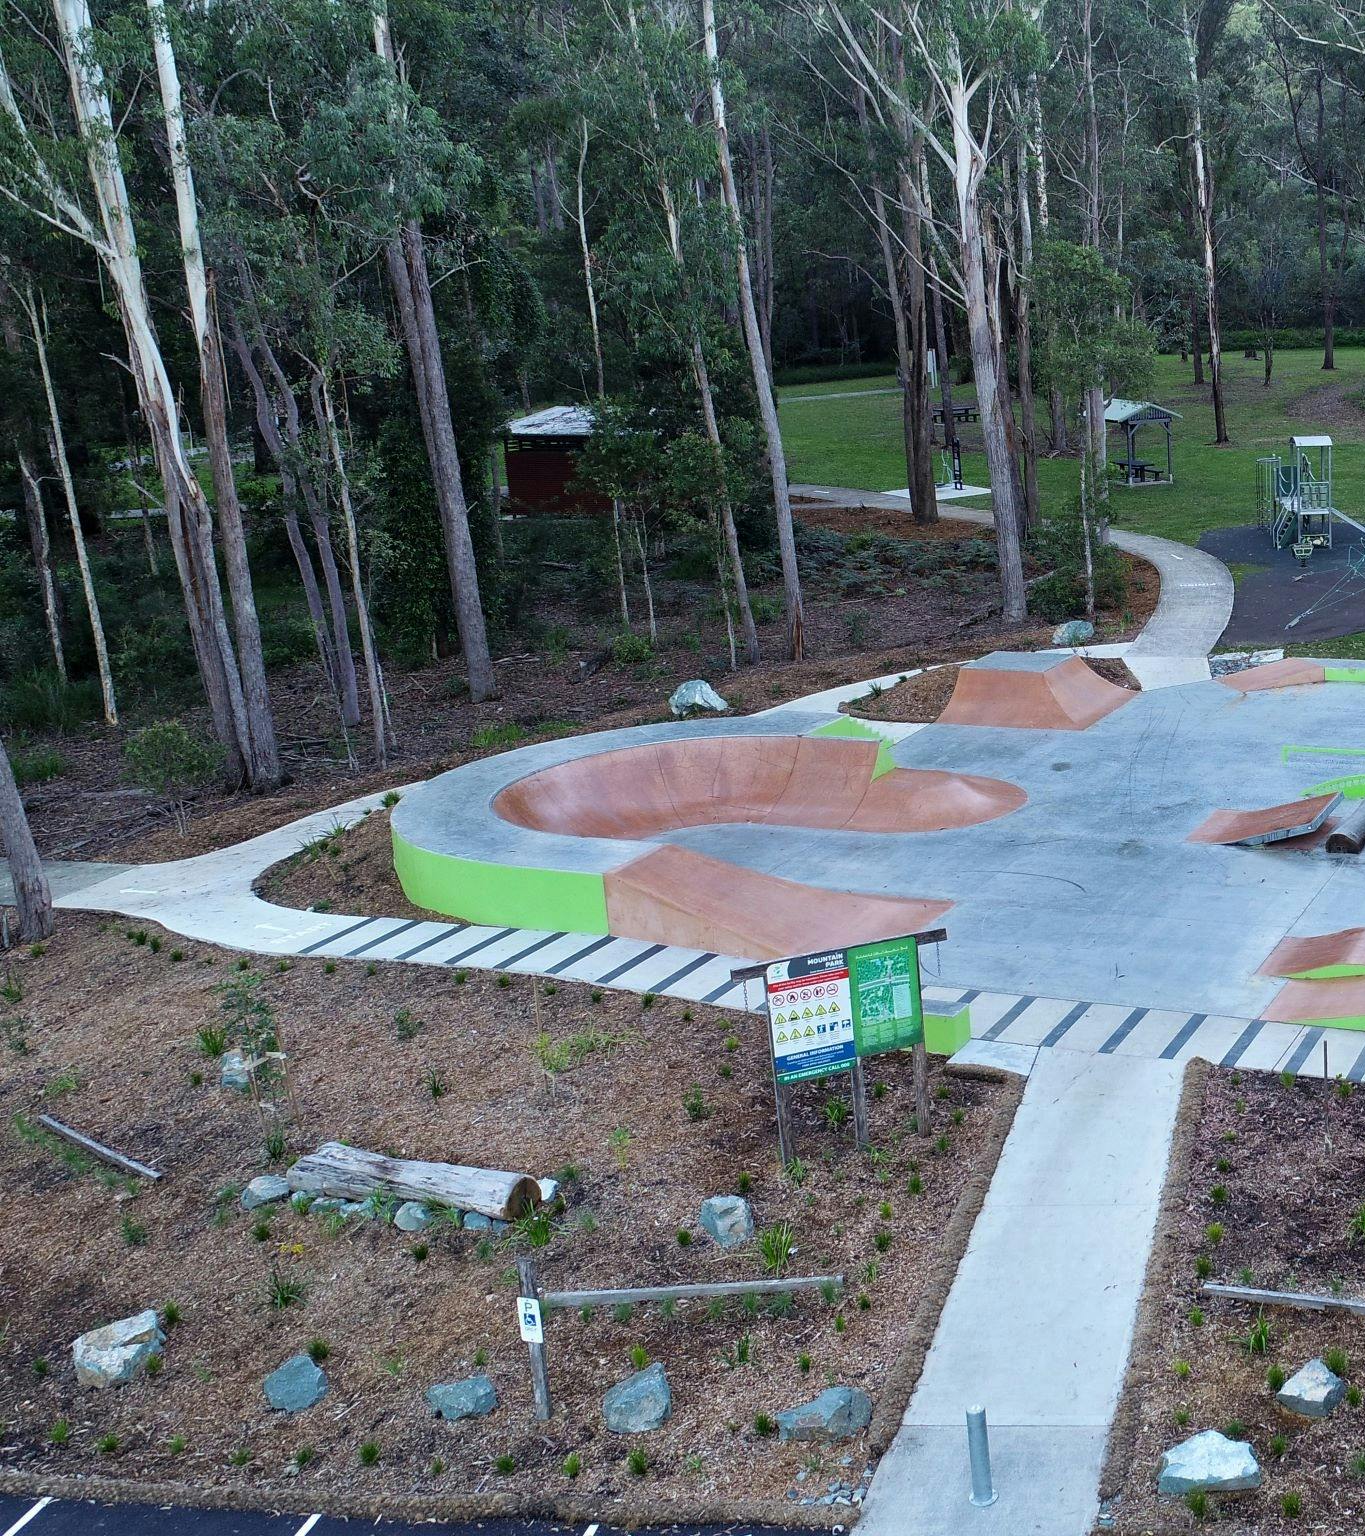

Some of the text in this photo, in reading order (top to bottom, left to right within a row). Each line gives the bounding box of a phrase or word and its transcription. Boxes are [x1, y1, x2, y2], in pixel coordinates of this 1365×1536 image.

[807, 953, 843, 965] MOUNTAIN
[825, 959, 844, 968] PARK
[786, 1052, 809, 1061] GENERAL
[810, 1044, 844, 1056] INFORMATION
[798, 1067, 827, 1078] EMERGENCY
[524, 1302, 532, 1312] P
